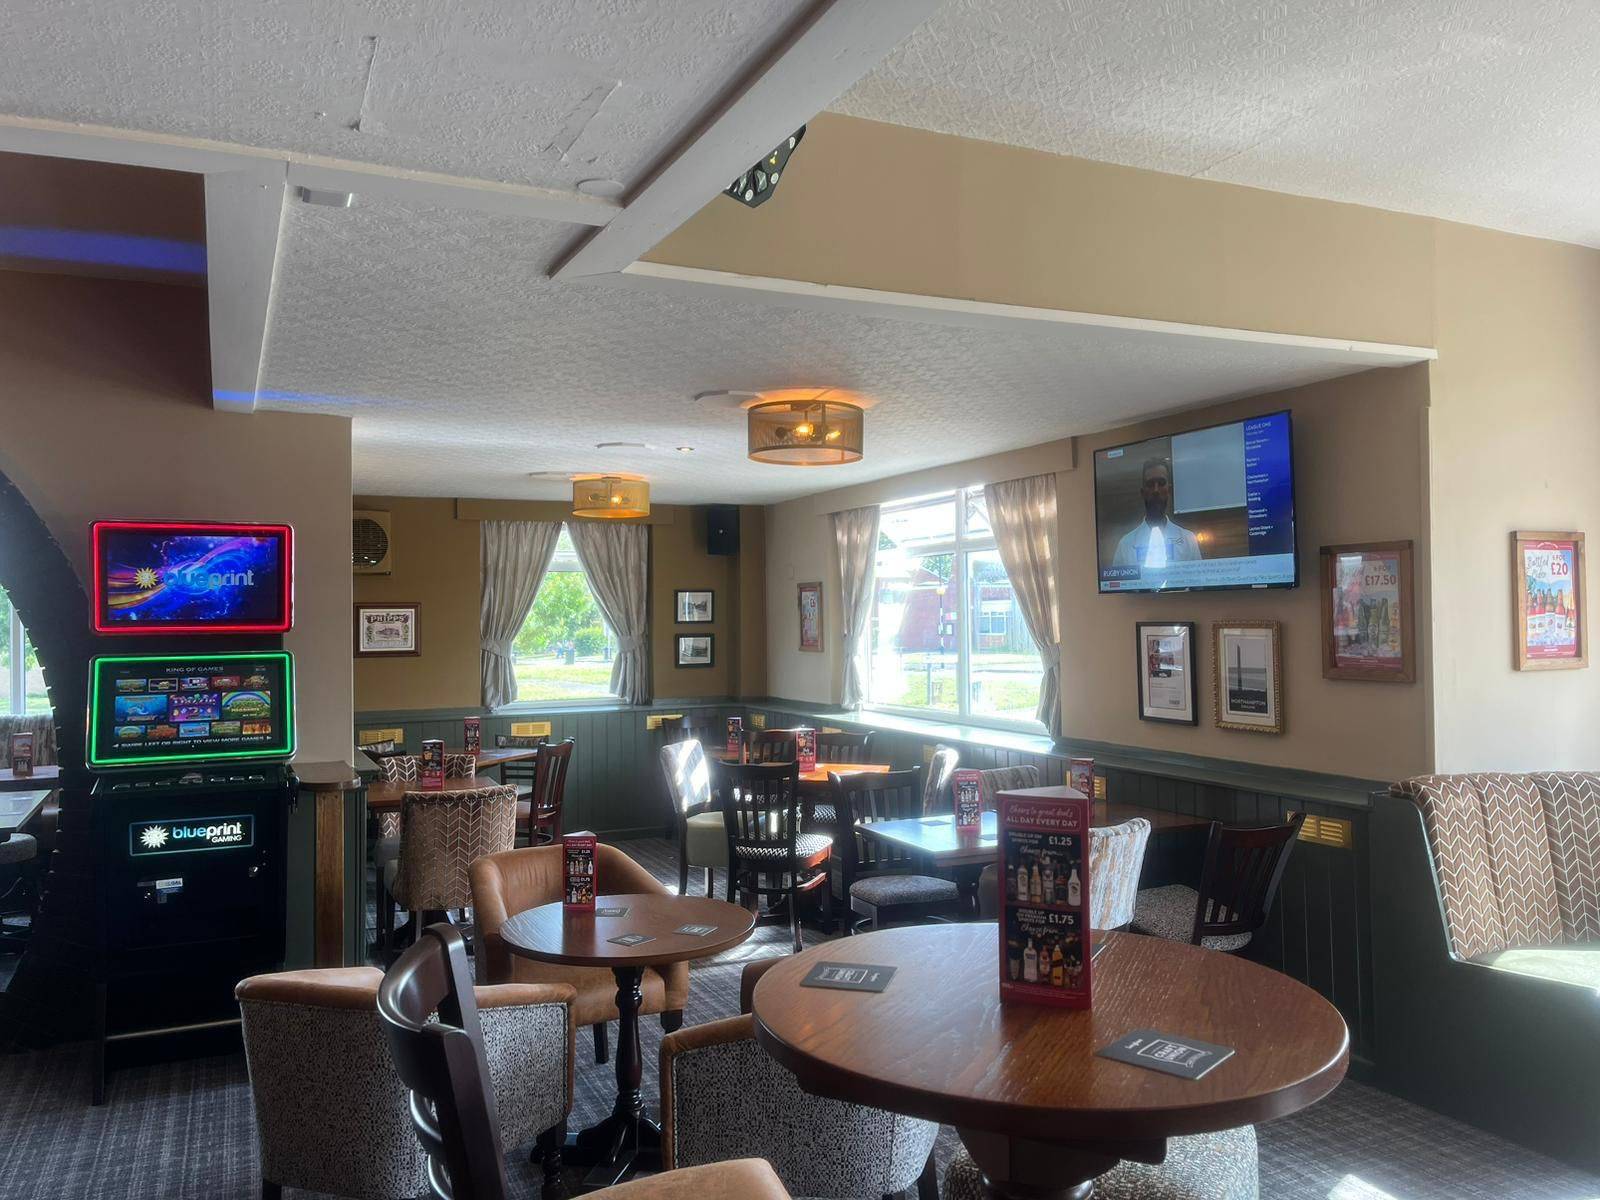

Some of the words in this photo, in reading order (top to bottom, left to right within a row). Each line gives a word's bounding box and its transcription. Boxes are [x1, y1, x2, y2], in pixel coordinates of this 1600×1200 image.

[1103, 568, 1120, 577] RUGBY
[1121, 567, 1138, 577] UNION
[1551, 562, 1569, 576] £20
[163, 569, 255, 590] blueprint
[1364, 574, 1397, 586] £17.50
[1020, 816, 1034, 824] DAY
[1036, 818, 1060, 827] EVERY
[172, 822, 242, 840] blueprint
[211, 834, 243, 844] GAMING
[1048, 835, 1072, 846] £1.25
[1049, 913, 1074, 925] £1.75
